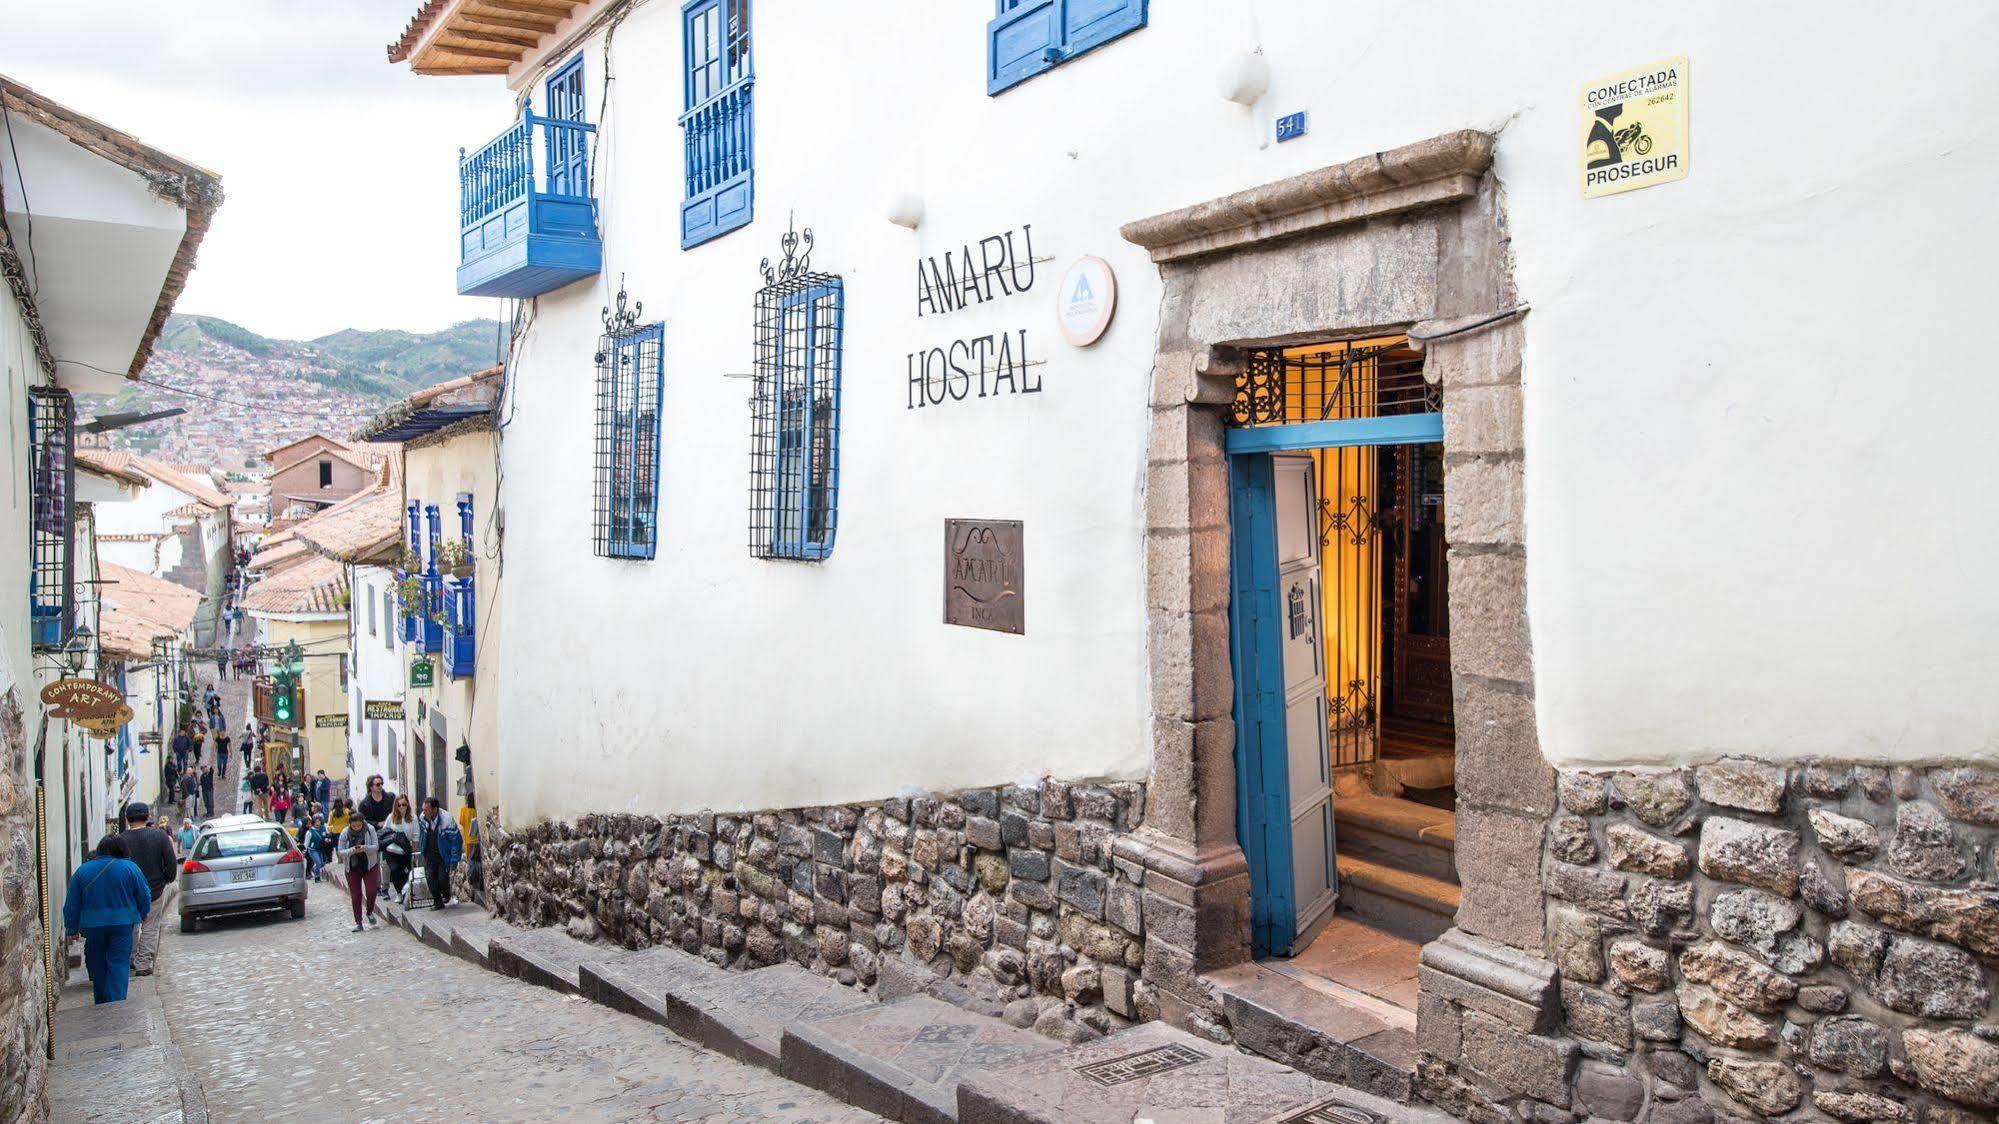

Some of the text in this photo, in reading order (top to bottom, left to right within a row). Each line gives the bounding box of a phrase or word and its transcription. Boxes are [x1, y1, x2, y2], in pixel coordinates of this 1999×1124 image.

[1587, 68, 1677, 103] CONECTADA
[1587, 80, 1677, 109] CON CENTRAL DE ALARMAS
[1647, 93, 1674, 106] 262642
[1587, 154, 1678, 186] PROSEGUR
[918, 224, 1034, 317] AMARU
[907, 329, 1042, 410] HOSTAL
[69, 692, 102, 707] ART
[367, 704, 406, 712] RESTAURAN
